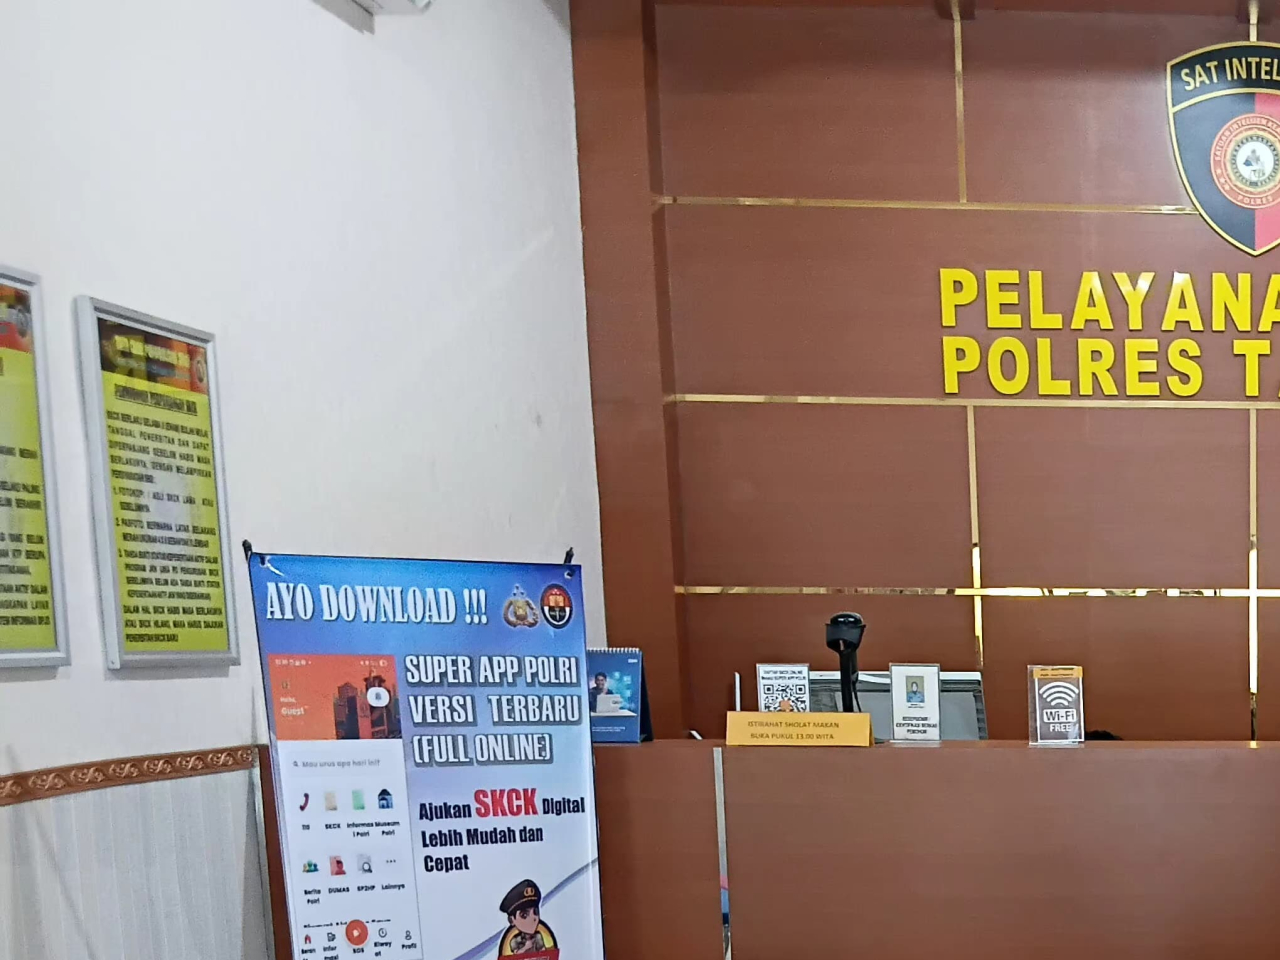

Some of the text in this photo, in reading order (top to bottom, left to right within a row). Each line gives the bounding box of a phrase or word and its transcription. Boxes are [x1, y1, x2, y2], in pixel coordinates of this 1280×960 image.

[1181, 61, 1218, 91] SAT
[942, 335, 1204, 398] POLRES
[266, 582, 489, 625] AYO DOWNLOAD !!!
[404, 655, 579, 686] SUPER APP POLRI
[281, 707, 305, 716] Guest
[409, 694, 581, 725] VERSI TERBARU
[1045, 710, 1075, 721] Wi-Fi
[1050, 724, 1071, 732] FREE
[412, 733, 553, 764] (FULL ONLINE)
[418, 788, 586, 822] Ajukan SKCK Digital
[421, 825, 544, 848] Lebih Mudah dan
[423, 854, 470, 873] Cepat
